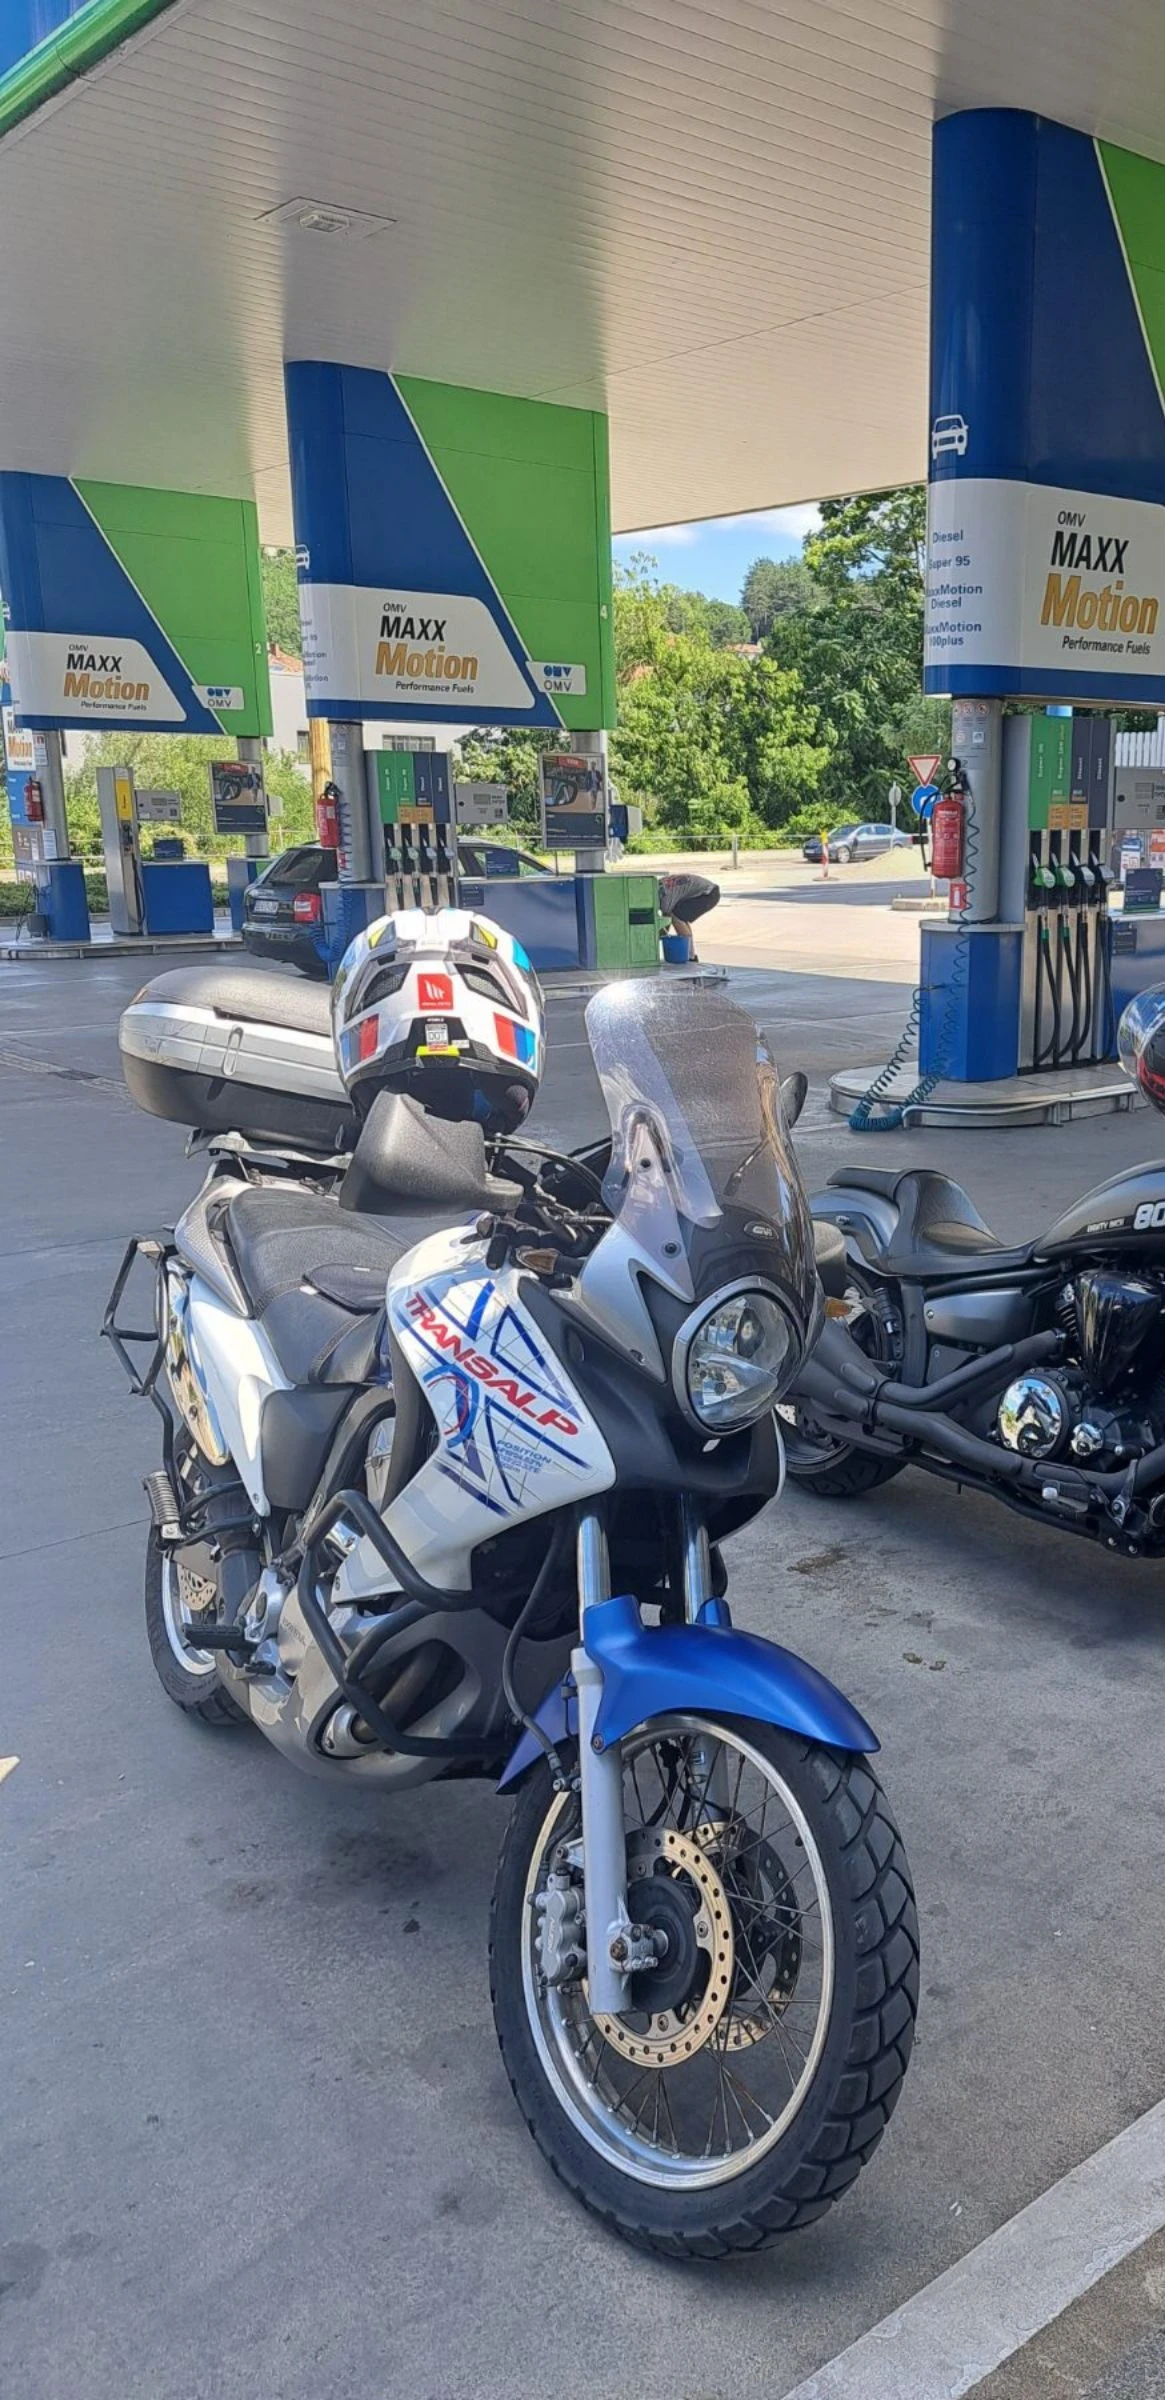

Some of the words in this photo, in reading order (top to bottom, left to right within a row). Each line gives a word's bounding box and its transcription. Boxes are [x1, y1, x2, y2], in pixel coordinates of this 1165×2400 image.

[1057, 510, 1087, 527] OMV
[932, 528, 965, 544] Diesel
[1050, 530, 1130, 574] MAXX
[928, 558, 953, 570] Super
[955, 554, 972, 567] 95
[925, 582, 985, 597] axxMotion
[383, 602, 407, 613] OMV
[930, 595, 963, 609] Diesel
[1040, 572, 1159, 635] Motion
[600, 604, 608, 620] 4
[379, 615, 447, 642] MAXX
[924, 620, 984, 633] axxMotion
[69, 644, 89, 652] OMV
[255, 644, 262, 655] 2
[1062, 635, 1124, 653] Performance
[1126, 638, 1151, 655] Fuels
[66, 653, 122, 673] MAXX
[375, 641, 479, 681] Motion
[63, 672, 150, 701] Motion
[395, 681, 450, 693] Performance
[452, 682, 475, 694] Fuels
[543, 680, 572, 692] OMV
[81, 700, 126, 710] Performance
[127, 703, 147, 711] Fuels
[207, 699, 232, 708] OMV
[405, 1291, 579, 1436] TRANSALP
[496, 1439, 552, 1464] POSITION
